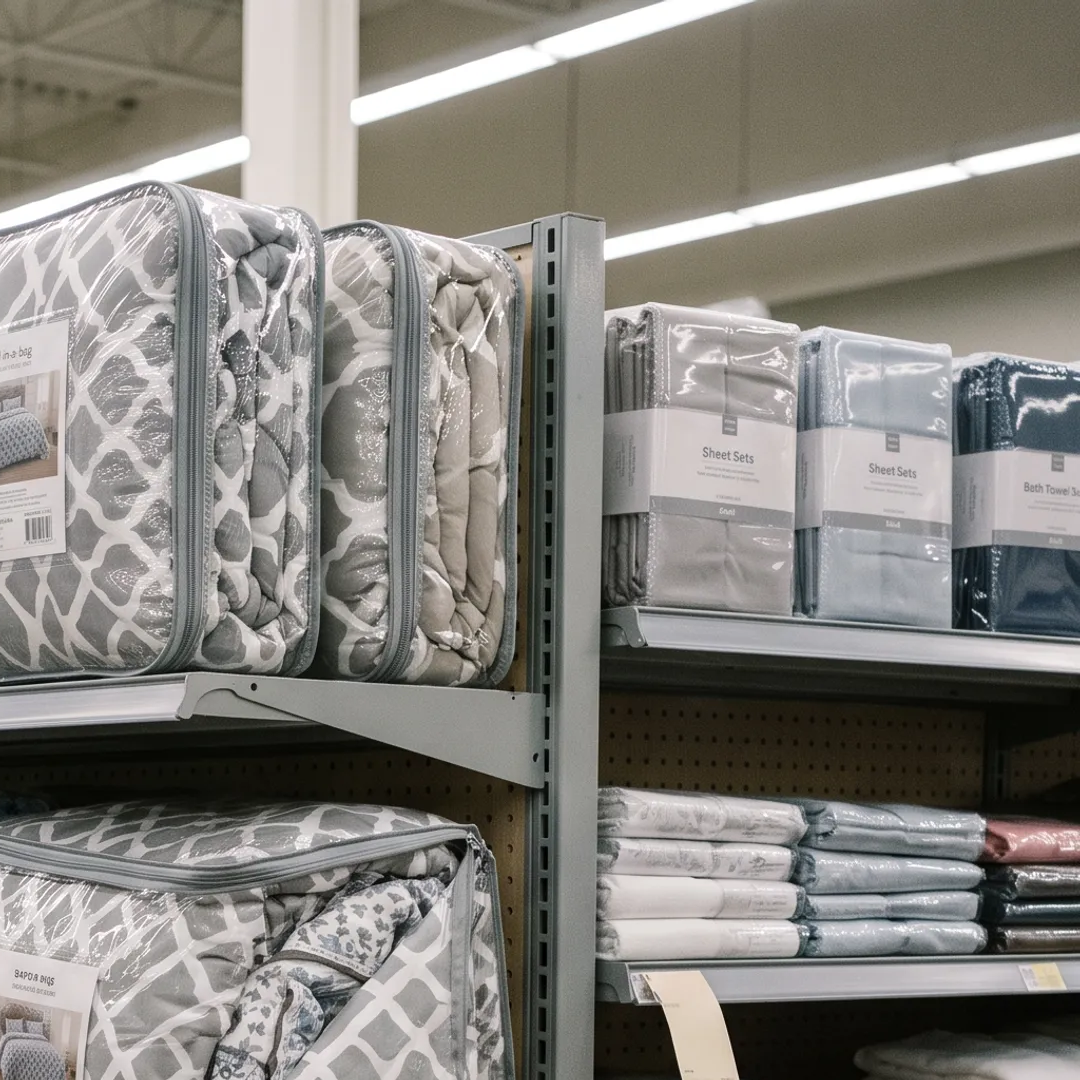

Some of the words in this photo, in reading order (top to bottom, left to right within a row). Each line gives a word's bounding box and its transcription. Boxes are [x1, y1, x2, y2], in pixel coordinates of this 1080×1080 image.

[702, 446, 732, 462] Sheet
[733, 451, 755, 465] Sets
[868, 462, 896, 477] Sheet
[897, 466, 918, 479] Sets
[1045, 484, 1071, 496] Towel
